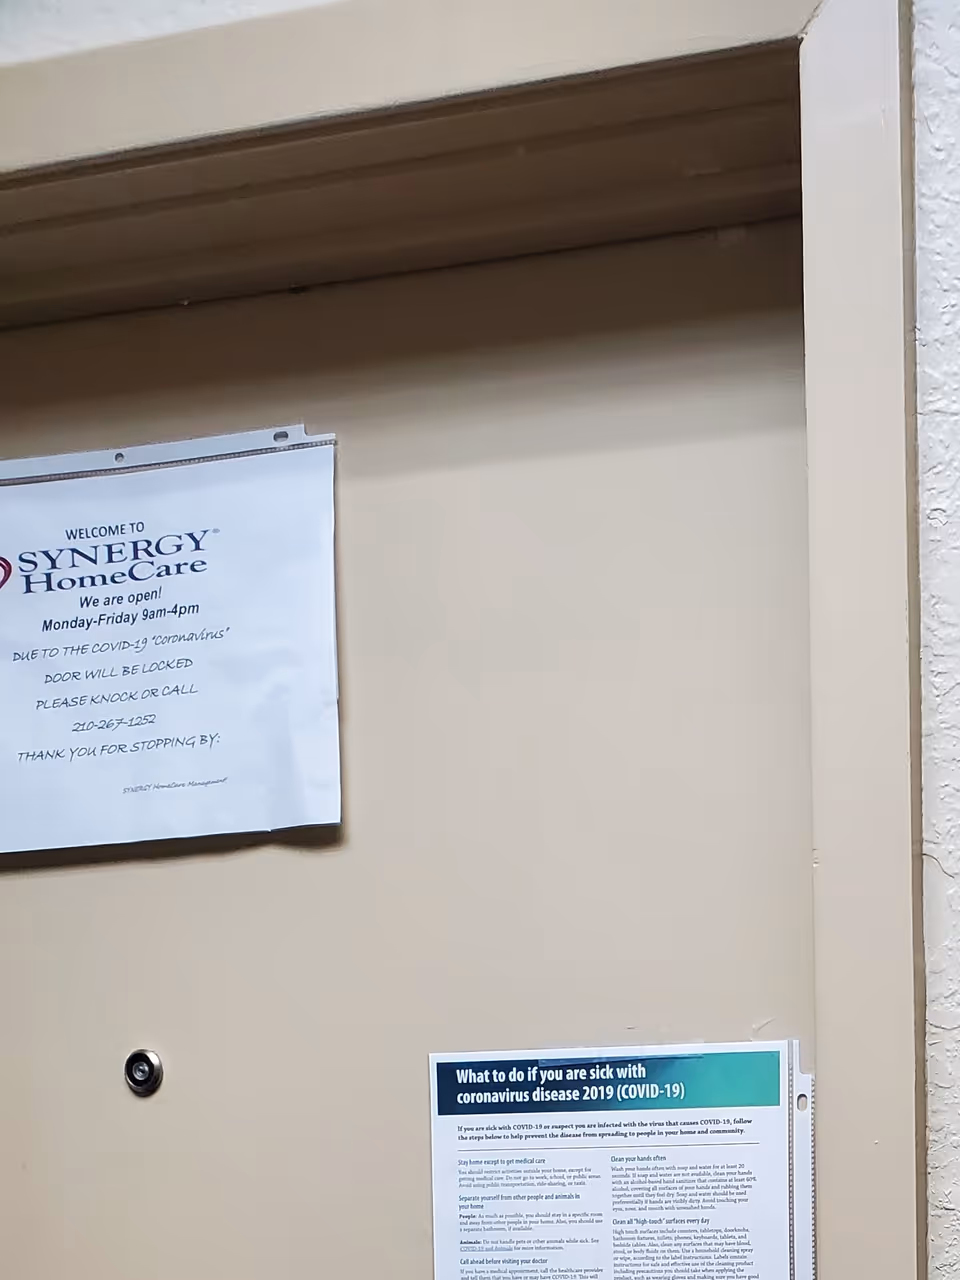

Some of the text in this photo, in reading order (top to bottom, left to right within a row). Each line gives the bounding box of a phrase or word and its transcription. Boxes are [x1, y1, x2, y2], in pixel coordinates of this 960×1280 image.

[65, 521, 145, 541] WELCOME TO
[18, 529, 209, 573] SYNERGY
[21, 559, 207, 594] HomeCare
[79, 586, 162, 609] We are open!
[42, 603, 199, 632] Monday-Friday 9am-4pm
[12, 649, 39, 661] DUE
[41, 647, 60, 659] TO
[62, 643, 90, 657] THE
[91, 637, 148, 654] COVID-19
[44, 658, 194, 684] DOOR WILL BE LOCKED
[36, 683, 198, 710] PLEASE KNOCK OR CALL
[71, 713, 157, 732] 210-267-1252
[18, 732, 220, 762] THANK YOU FOR STOPPING BY:
[456, 1063, 646, 1084] What to do if you are sick with
[457, 1082, 684, 1104] coronavirus disease 2019 (COVID-19)
[700, 1118, 732, 1126] COVID-19,
[598, 1131, 628, 1139] spreading
[636, 1130, 656, 1138] people
[458, 1159, 468, 1167] Stay
[458, 1195, 480, 1203] Separate
[480, 1194, 500, 1202] yourself
[527, 1193, 544, 1201] people
[700, 1217, 710, 1226] day
[502, 1258, 520, 1266] visiting
